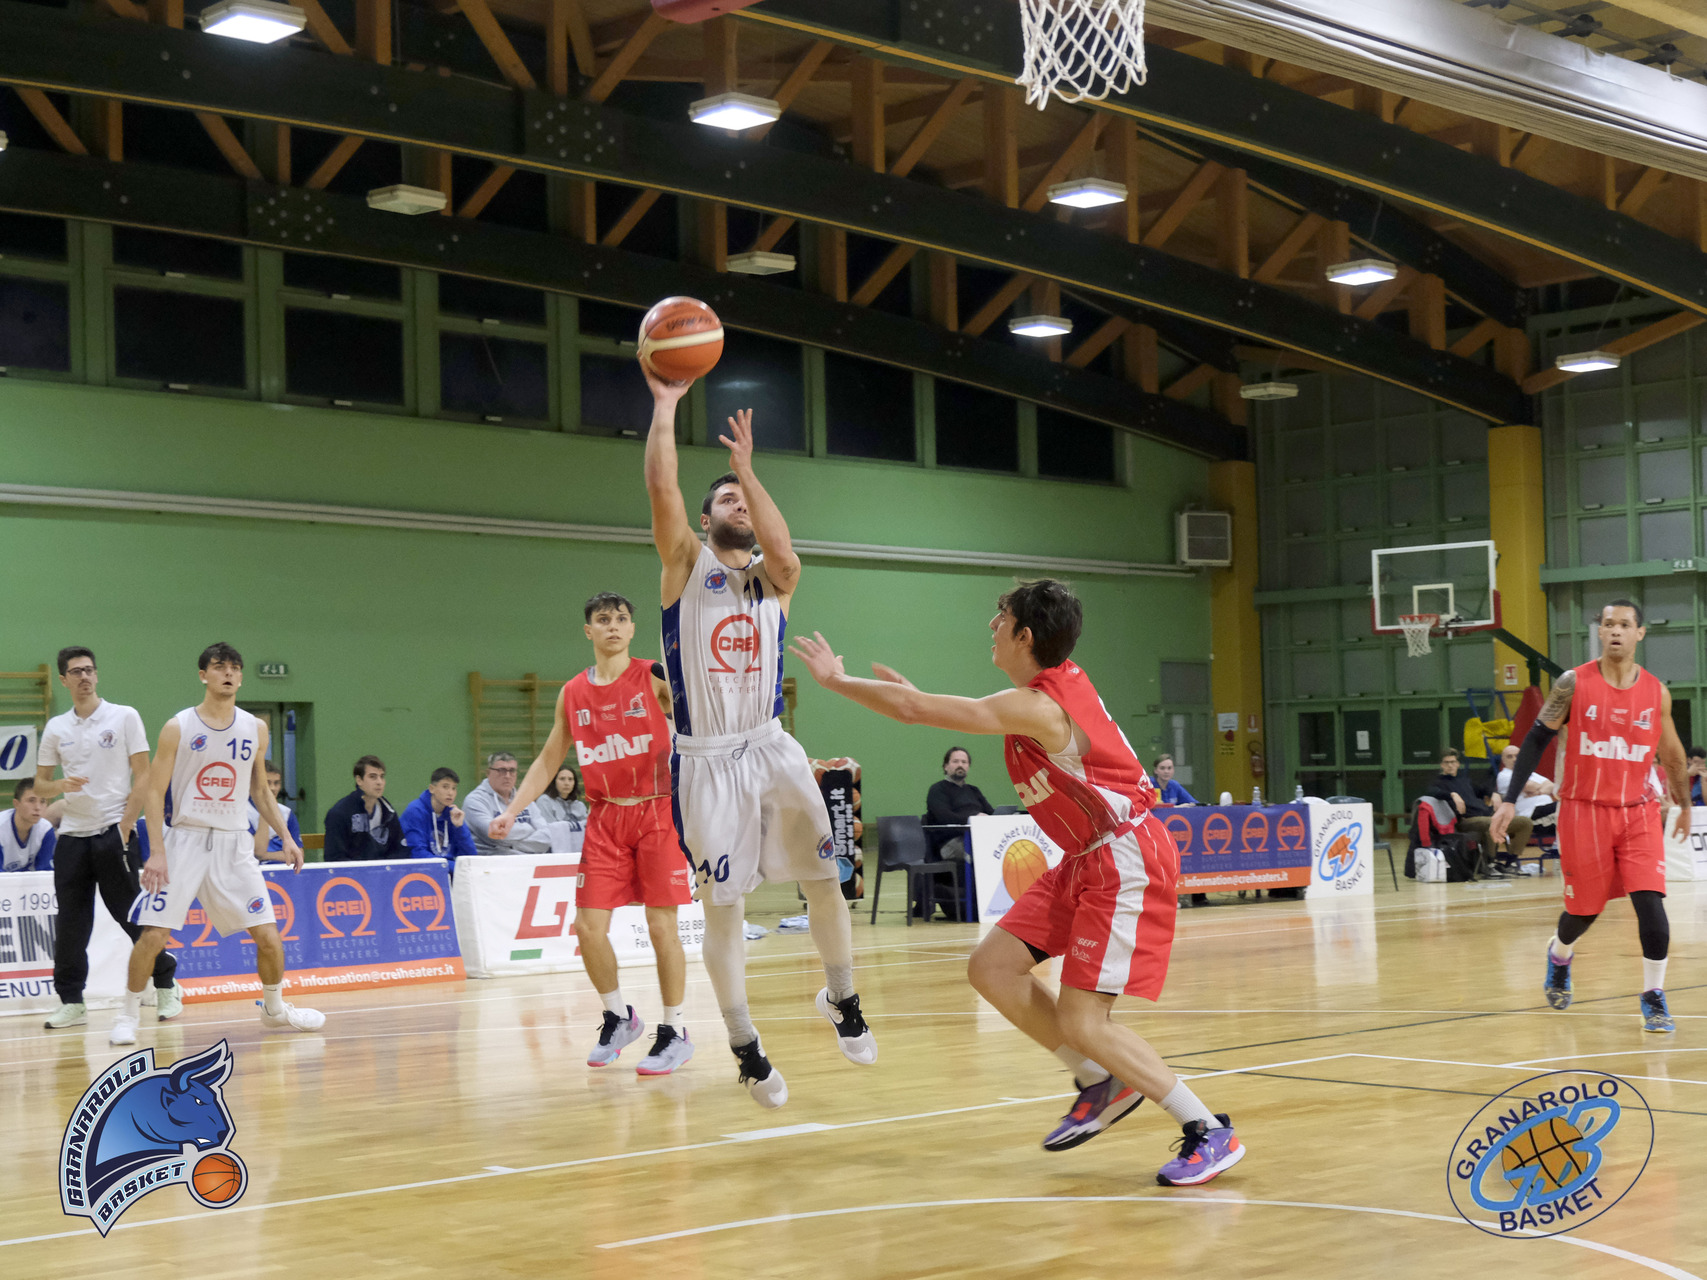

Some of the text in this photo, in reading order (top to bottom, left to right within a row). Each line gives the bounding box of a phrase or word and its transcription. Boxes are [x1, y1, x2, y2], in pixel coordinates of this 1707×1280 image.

[718, 636, 754, 652] CRE
[575, 708, 591, 727] 10
[1585, 704, 1598, 720] 4
[227, 738, 252, 761] 15
[575, 733, 653, 767] baltur
[1579, 731, 1651, 762] baltur
[993, 824, 1053, 860] Basket Village
[1314, 810, 1353, 858] GRANAROLO
[1335, 862, 1366, 891] BASKET
[1564, 884, 1575, 899] 4
[144, 891, 168, 912] 15
[324, 900, 365, 917] CREI
[400, 895, 440, 912] CREI
[631, 924, 648, 935] Tel.
[321, 937, 378, 950] ELECTRIC
[397, 932, 452, 944] ELECTRIC
[635, 938, 650, 949] Fax
[174, 948, 220, 961] ECTRIC
[323, 949, 380, 961] HEATERS
[399, 943, 454, 955] HEATERS
[179, 961, 222, 972] ATERS
[299, 964, 455, 987] information@creiheaters.it
